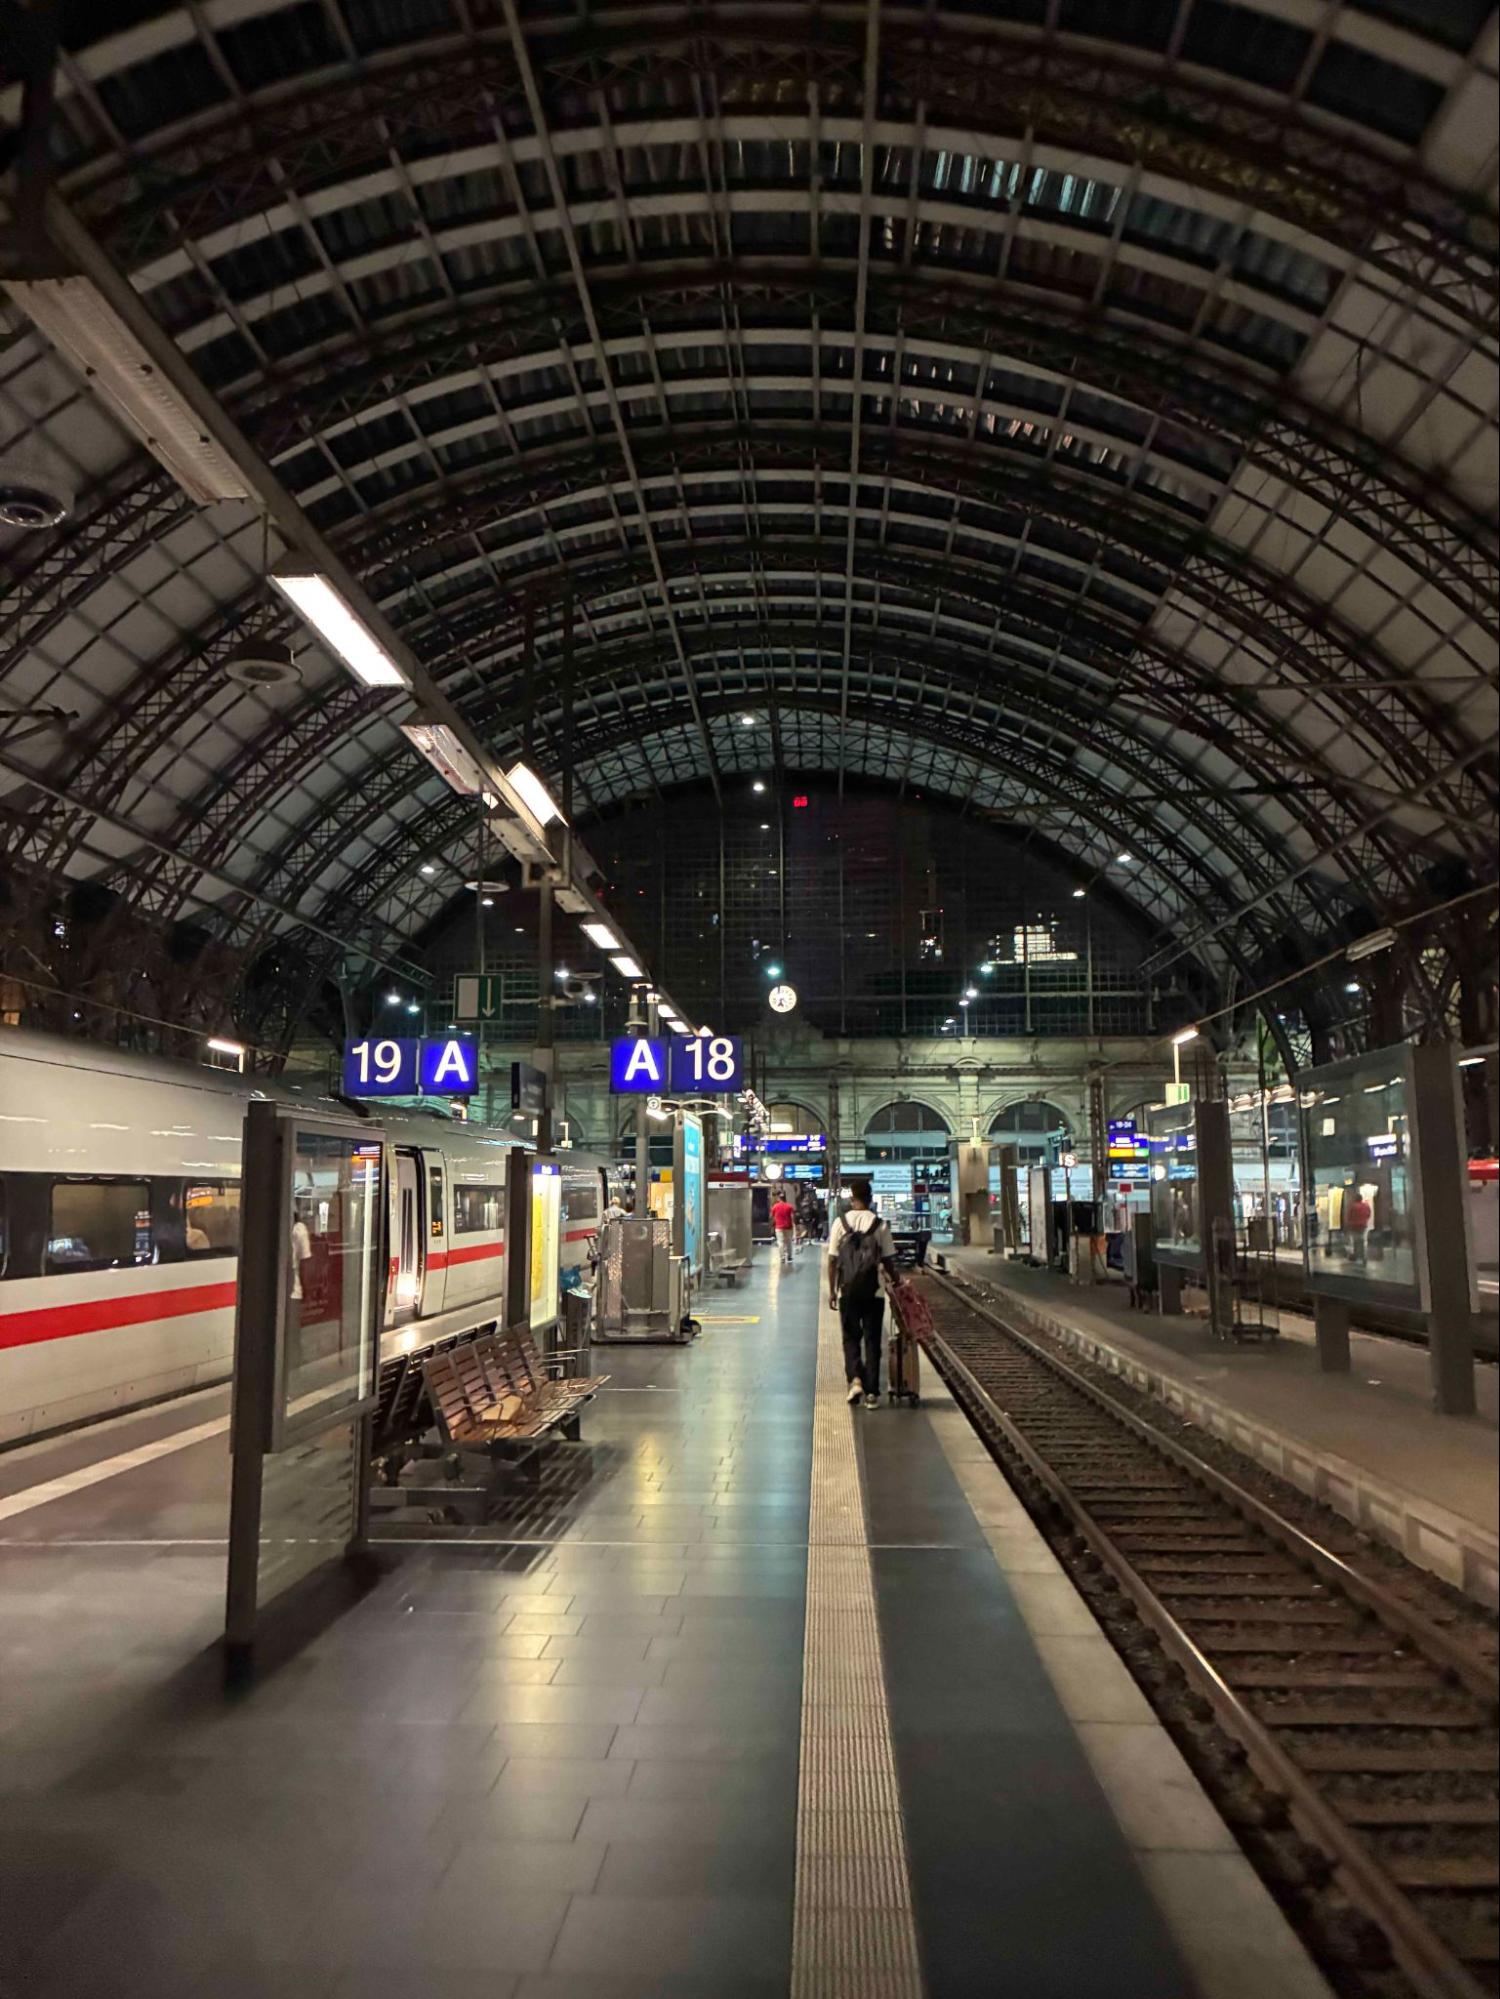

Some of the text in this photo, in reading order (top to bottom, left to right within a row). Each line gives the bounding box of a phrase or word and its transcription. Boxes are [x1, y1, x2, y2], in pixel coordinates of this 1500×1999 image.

[352, 1040, 470, 1083] 19 A
[624, 1037, 735, 1081] A 18
